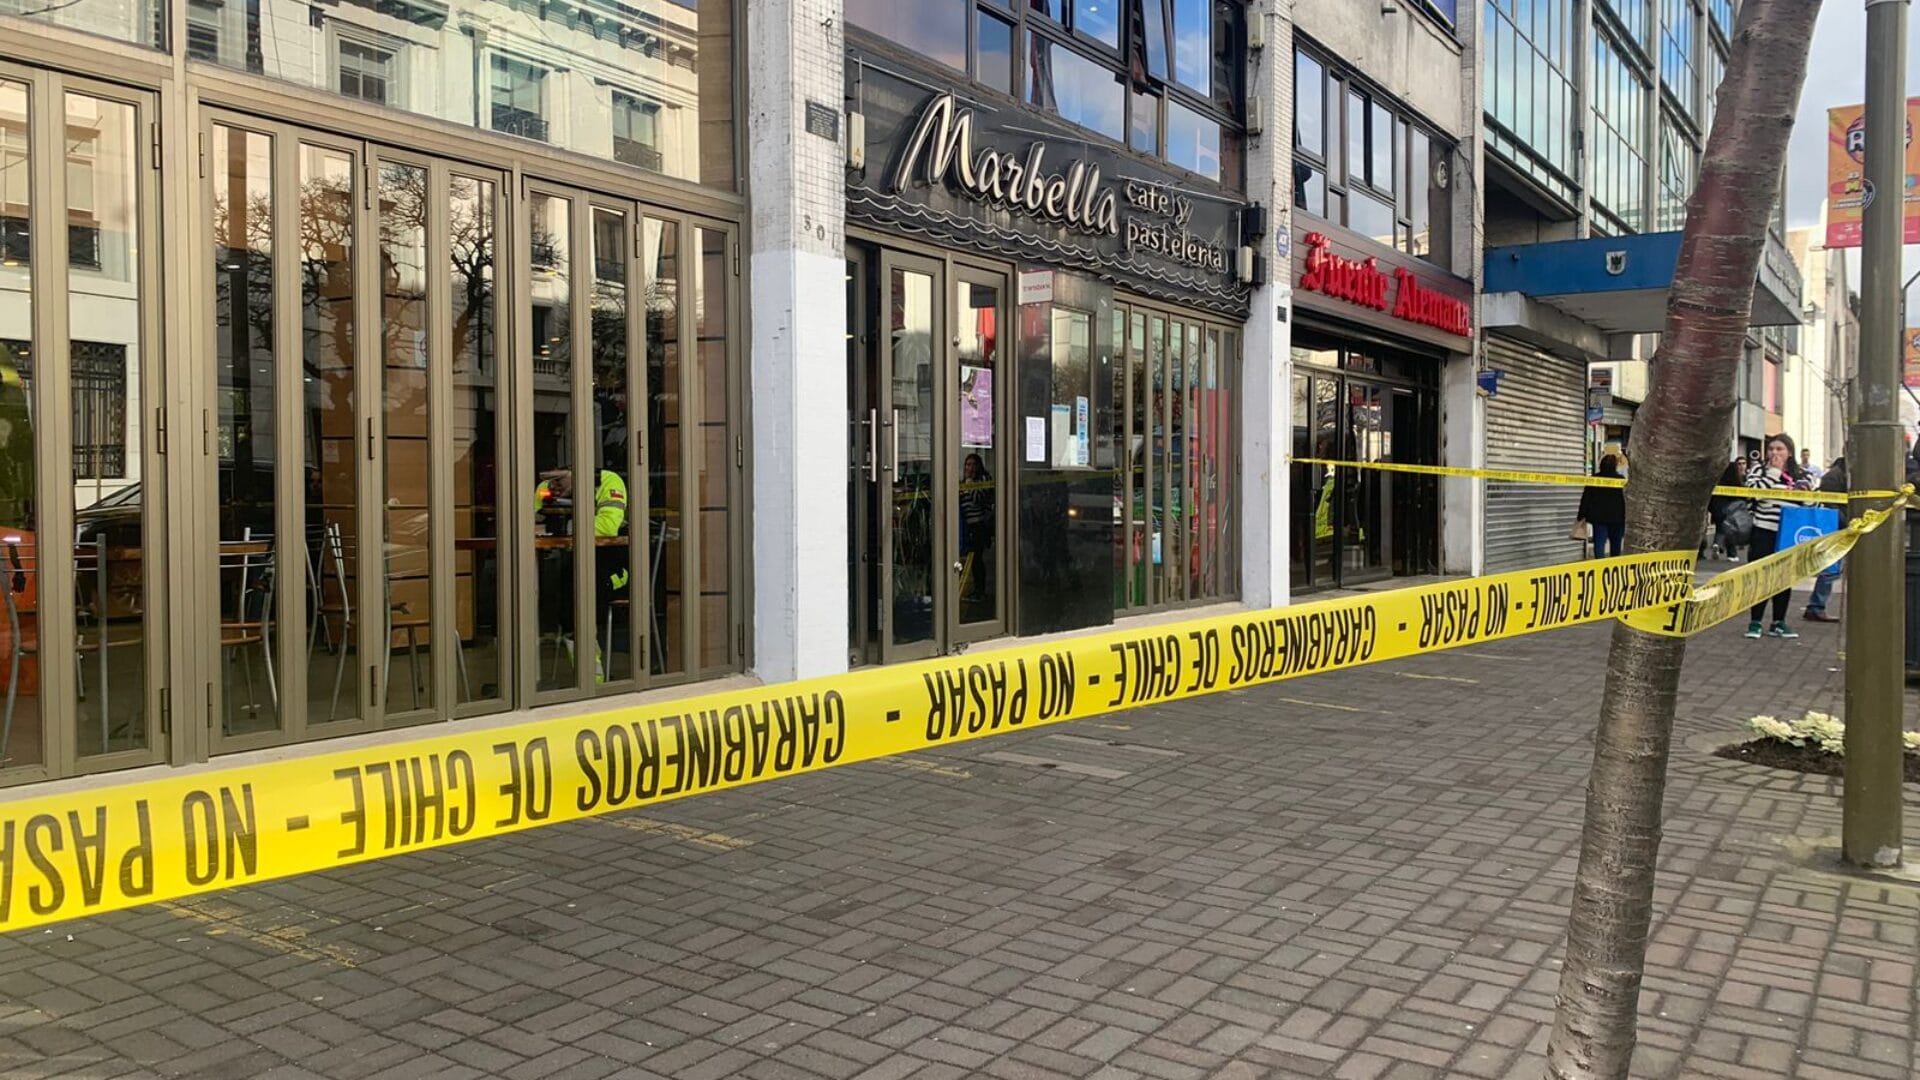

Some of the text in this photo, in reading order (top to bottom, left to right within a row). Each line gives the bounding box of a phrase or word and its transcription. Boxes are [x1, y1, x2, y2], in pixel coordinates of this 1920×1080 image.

[897, 93, 1118, 236] Marbella
[1301, 232, 1472, 337] Fuente Alemana
[1419, 586, 1480, 648] PASAR
[1484, 582, 1508, 634] NO
[1526, 572, 1571, 628] CHILE
[1573, 569, 1595, 619] DE
[1108, 634, 1181, 707] CHILE
[1187, 629, 1221, 690] DE
[1229, 605, 1377, 684] CARABINEROS
[922, 658, 1028, 741] PASAR
[1038, 651, 1077, 719] NO
[494, 736, 552, 829] DE
[576, 689, 845, 811] CARABINEROS
[182, 783, 258, 887] NO
[334, 749, 476, 858] CHILE
